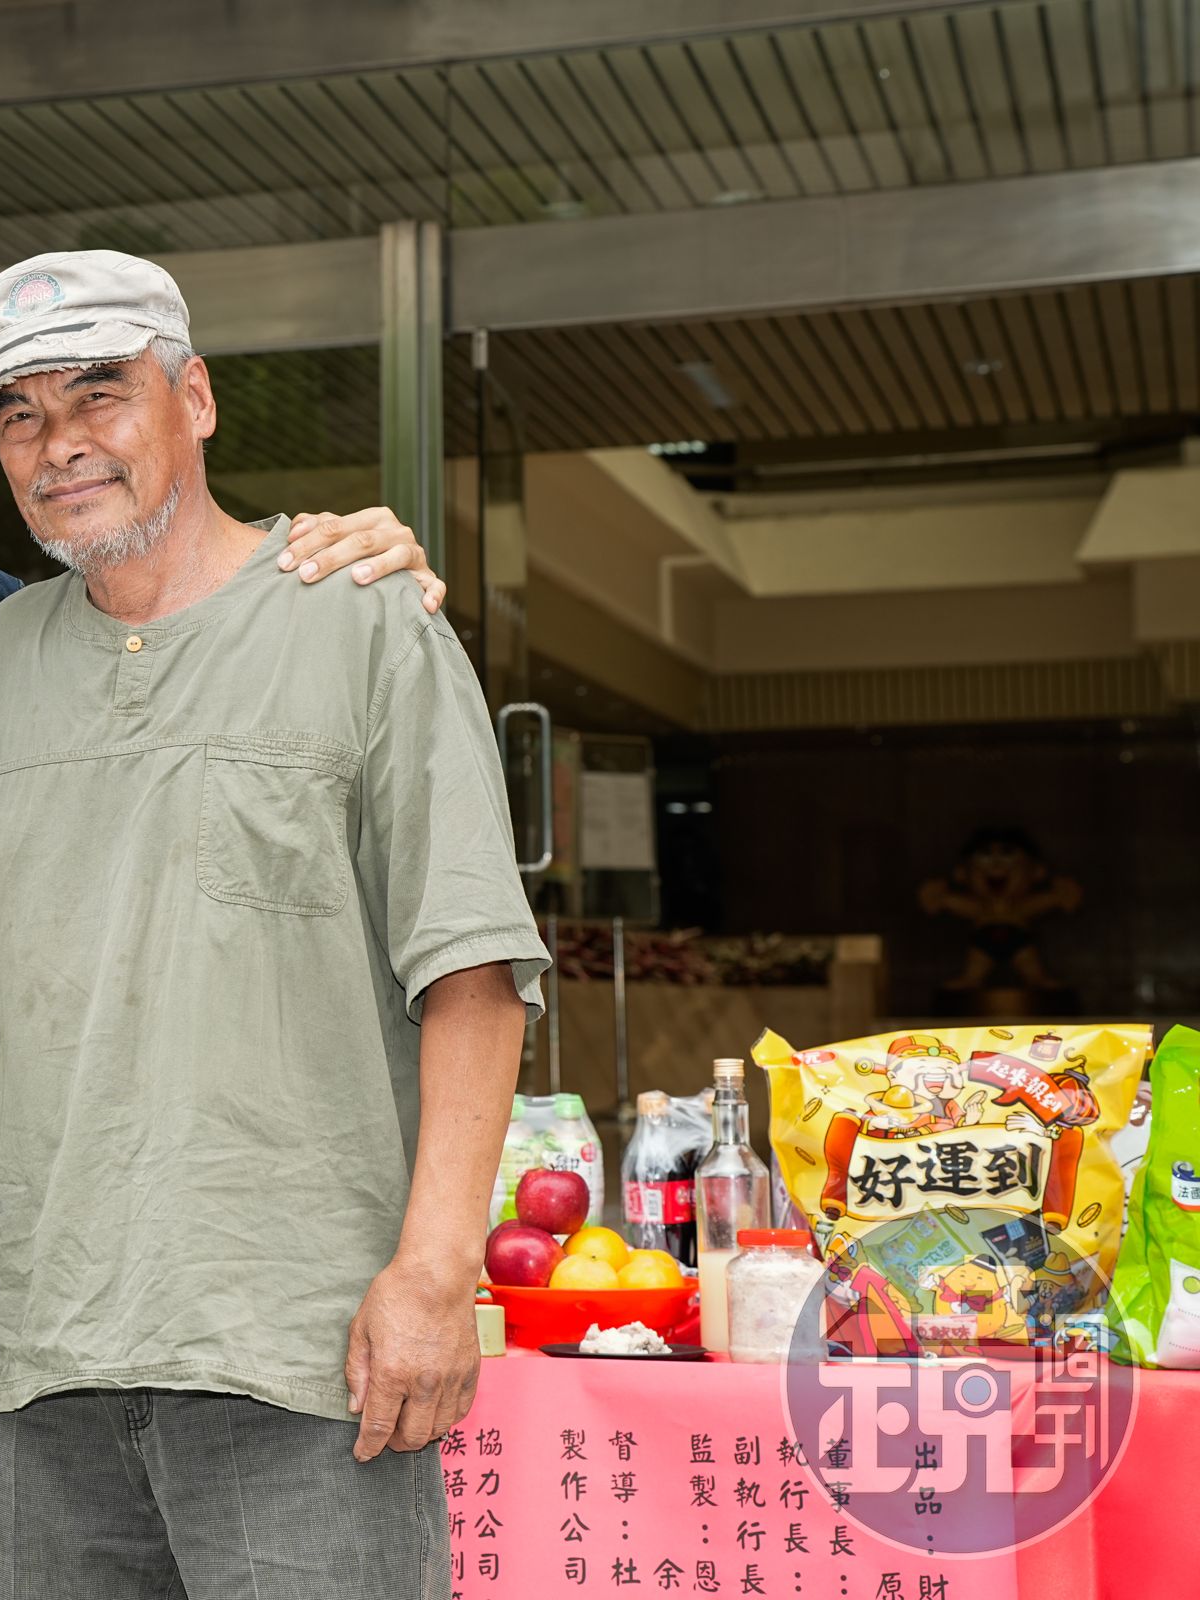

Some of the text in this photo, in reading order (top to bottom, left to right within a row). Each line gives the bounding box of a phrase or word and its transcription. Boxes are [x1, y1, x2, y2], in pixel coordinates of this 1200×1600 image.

[973, 1060, 1063, 1113] 一起來報到
[851, 1141, 1046, 1207] 好運到
[560, 1429, 591, 1585] 製作公司
[733, 1435, 767, 1595] 副執行長
